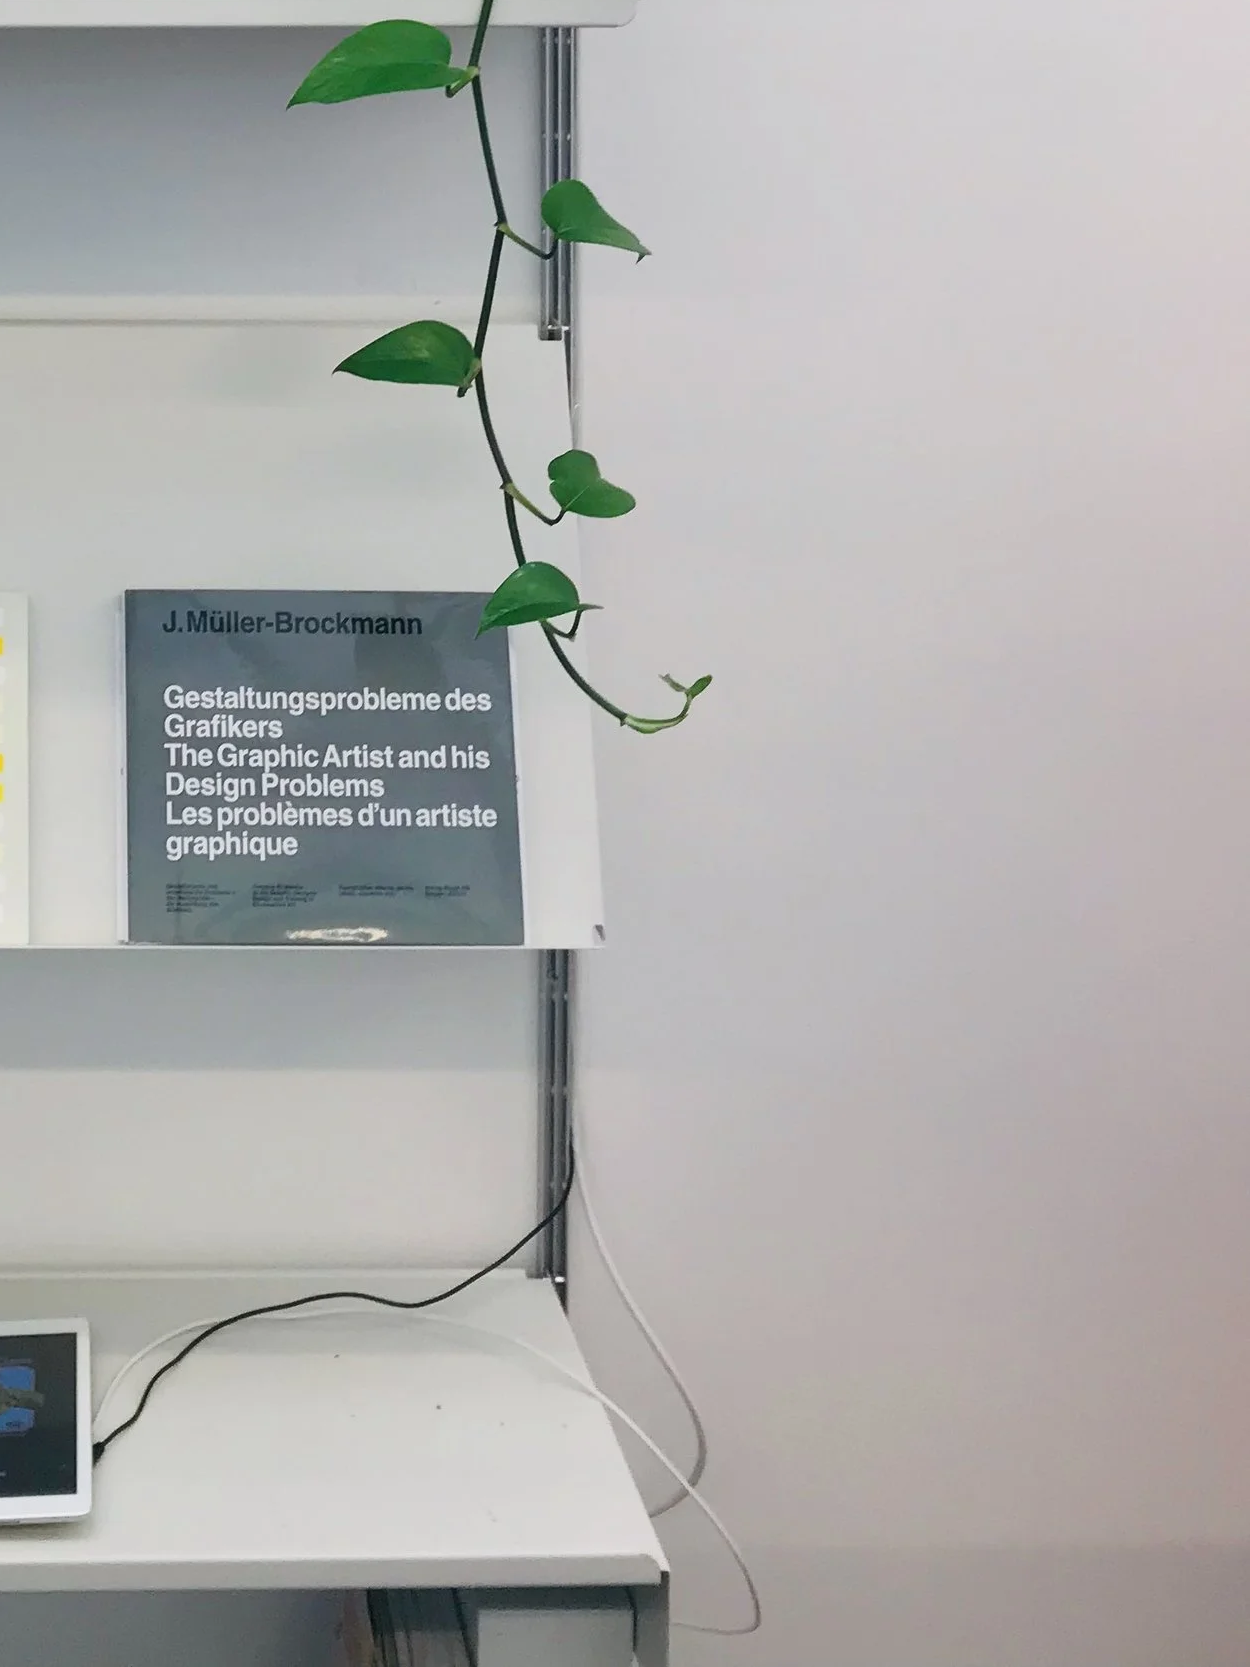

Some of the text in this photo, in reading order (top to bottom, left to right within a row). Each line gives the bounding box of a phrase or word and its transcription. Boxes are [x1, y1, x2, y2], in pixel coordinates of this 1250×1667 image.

[163, 684, 492, 716] Gestaltungsprobleme des
[163, 713, 283, 739] Grafikers
[163, 742, 491, 774] The Graphic Artist and his
[165, 771, 385, 802] Design Problems
[165, 801, 498, 832] Les problèmes d'un artiste
[165, 830, 299, 861] graphique
